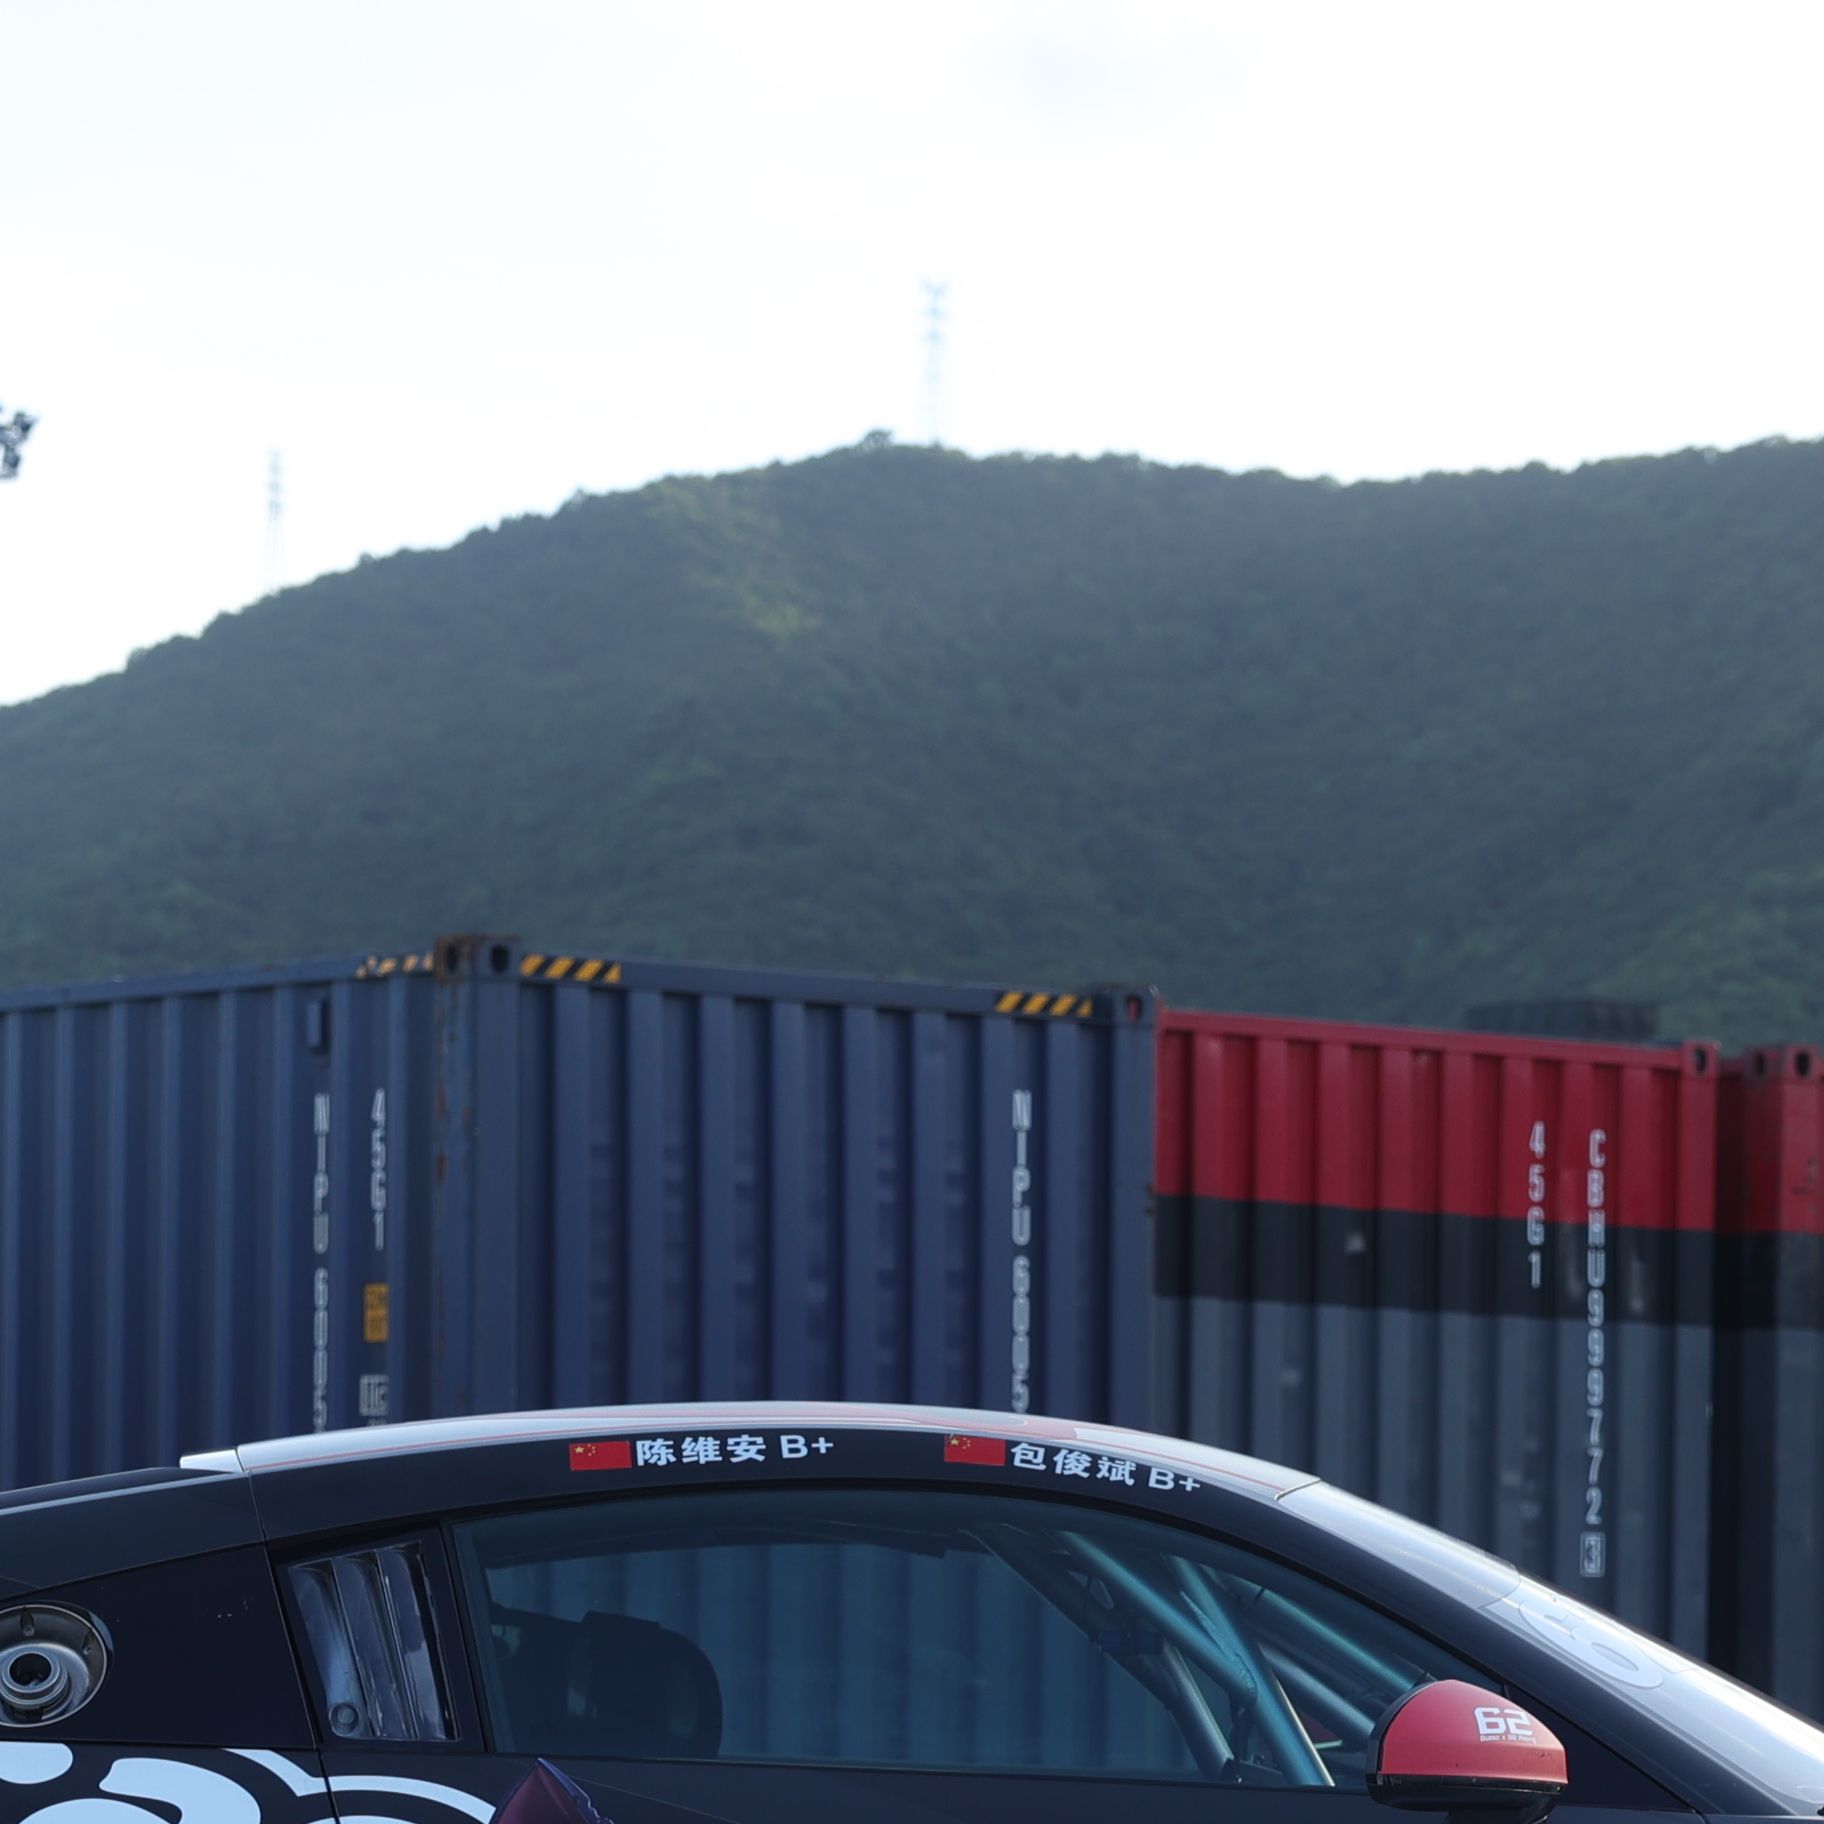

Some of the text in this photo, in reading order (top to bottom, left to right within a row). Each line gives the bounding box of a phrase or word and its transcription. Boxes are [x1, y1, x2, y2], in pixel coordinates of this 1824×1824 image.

[1012, 1088, 1032, 1246] NIPU
[1527, 1120, 1546, 1290] 45G1
[635, 1434, 834, 1467] 陈维安 B+
[1011, 1442, 1201, 1491] 包俊斌 B+
[1474, 1706, 1534, 1736] 62
